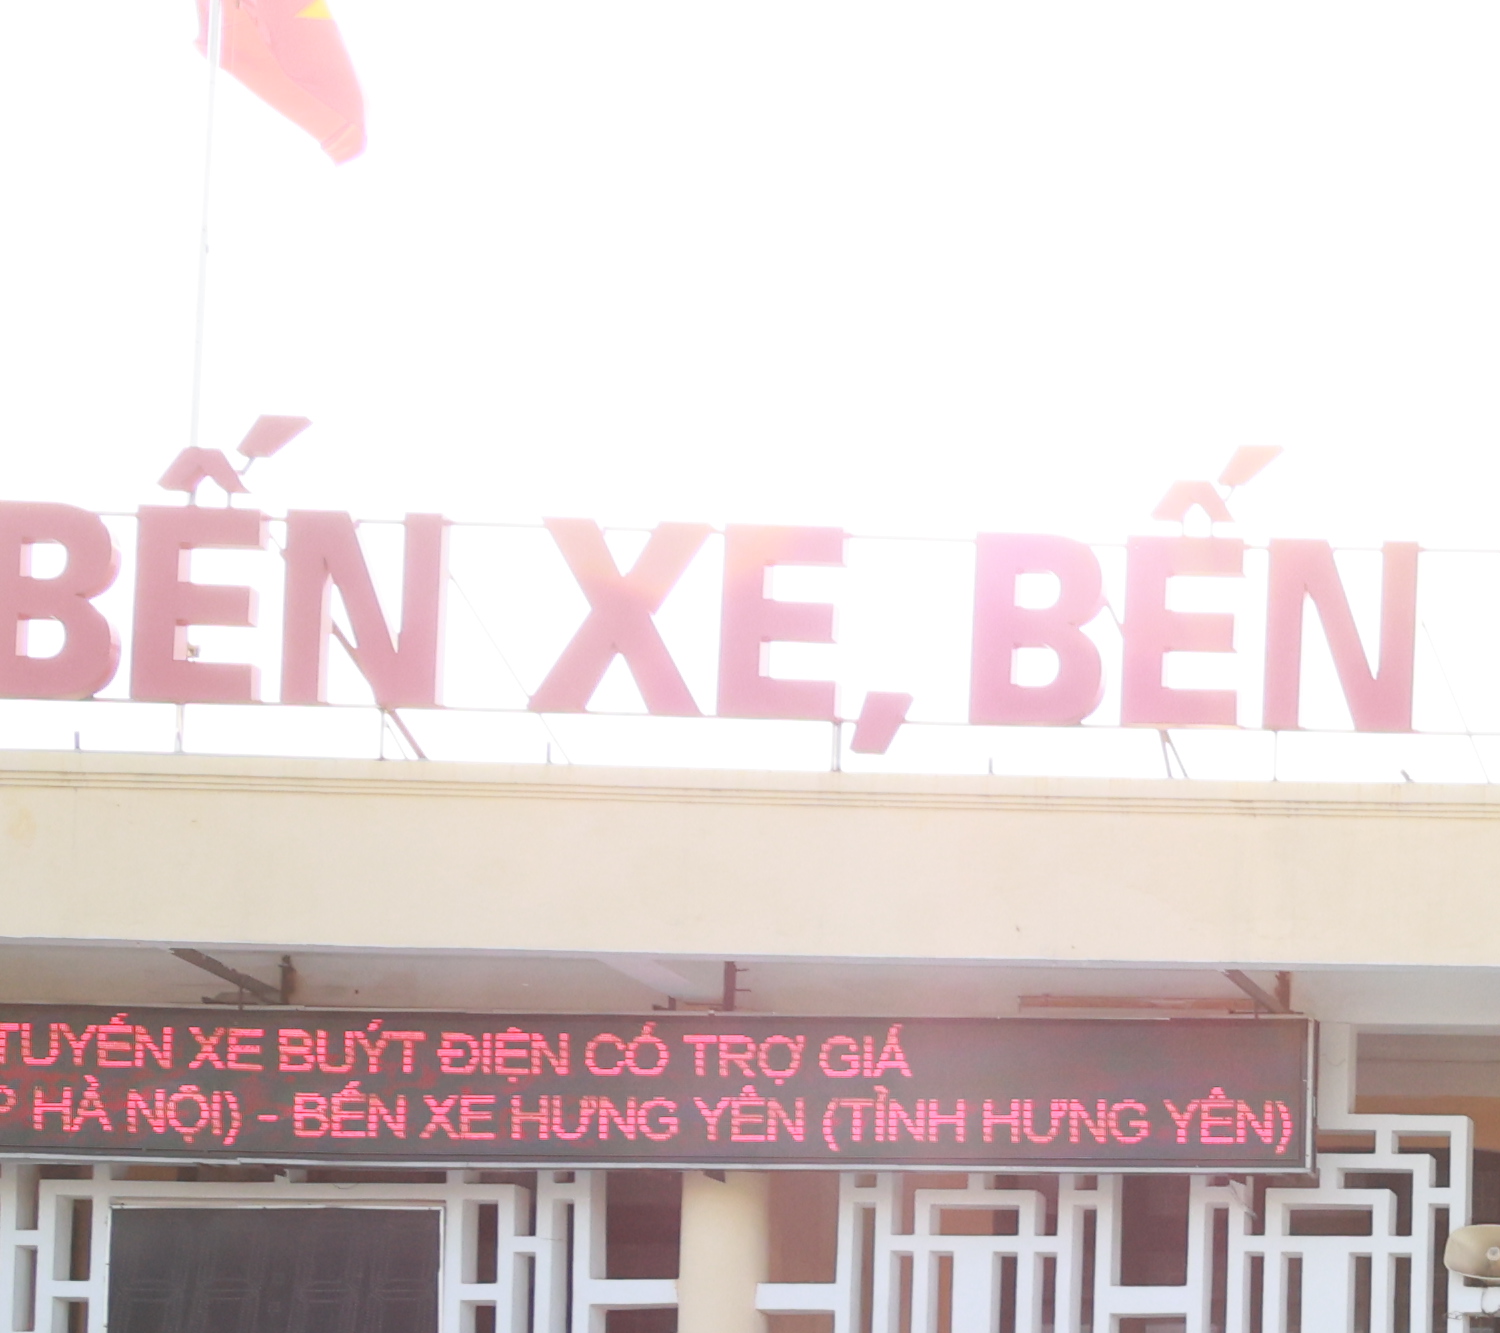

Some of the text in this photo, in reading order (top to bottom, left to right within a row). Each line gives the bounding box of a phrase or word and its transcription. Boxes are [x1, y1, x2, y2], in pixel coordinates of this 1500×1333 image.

[0, 414, 449, 708] BẾN
[533, 518, 913, 756] XE,
[968, 445, 1420, 734] BẾN
[0, 1013, 913, 1086] TUYẾN XE BUÝT ĐIỆN CÓ TRỢ GIÁ
[33, 1074, 113, 1133] HÀ
[127, 1085, 241, 1145] NỘI)
[293, 1081, 406, 1140] BẾN
[420, 1093, 496, 1141] XE
[509, 1091, 679, 1141] HƯNG
[693, 1084, 805, 1144] YÊN
[821, 1085, 966, 1152] (TỈNH
[981, 1097, 1150, 1146] HƯNG
[1163, 1086, 1293, 1155] YÊN)
